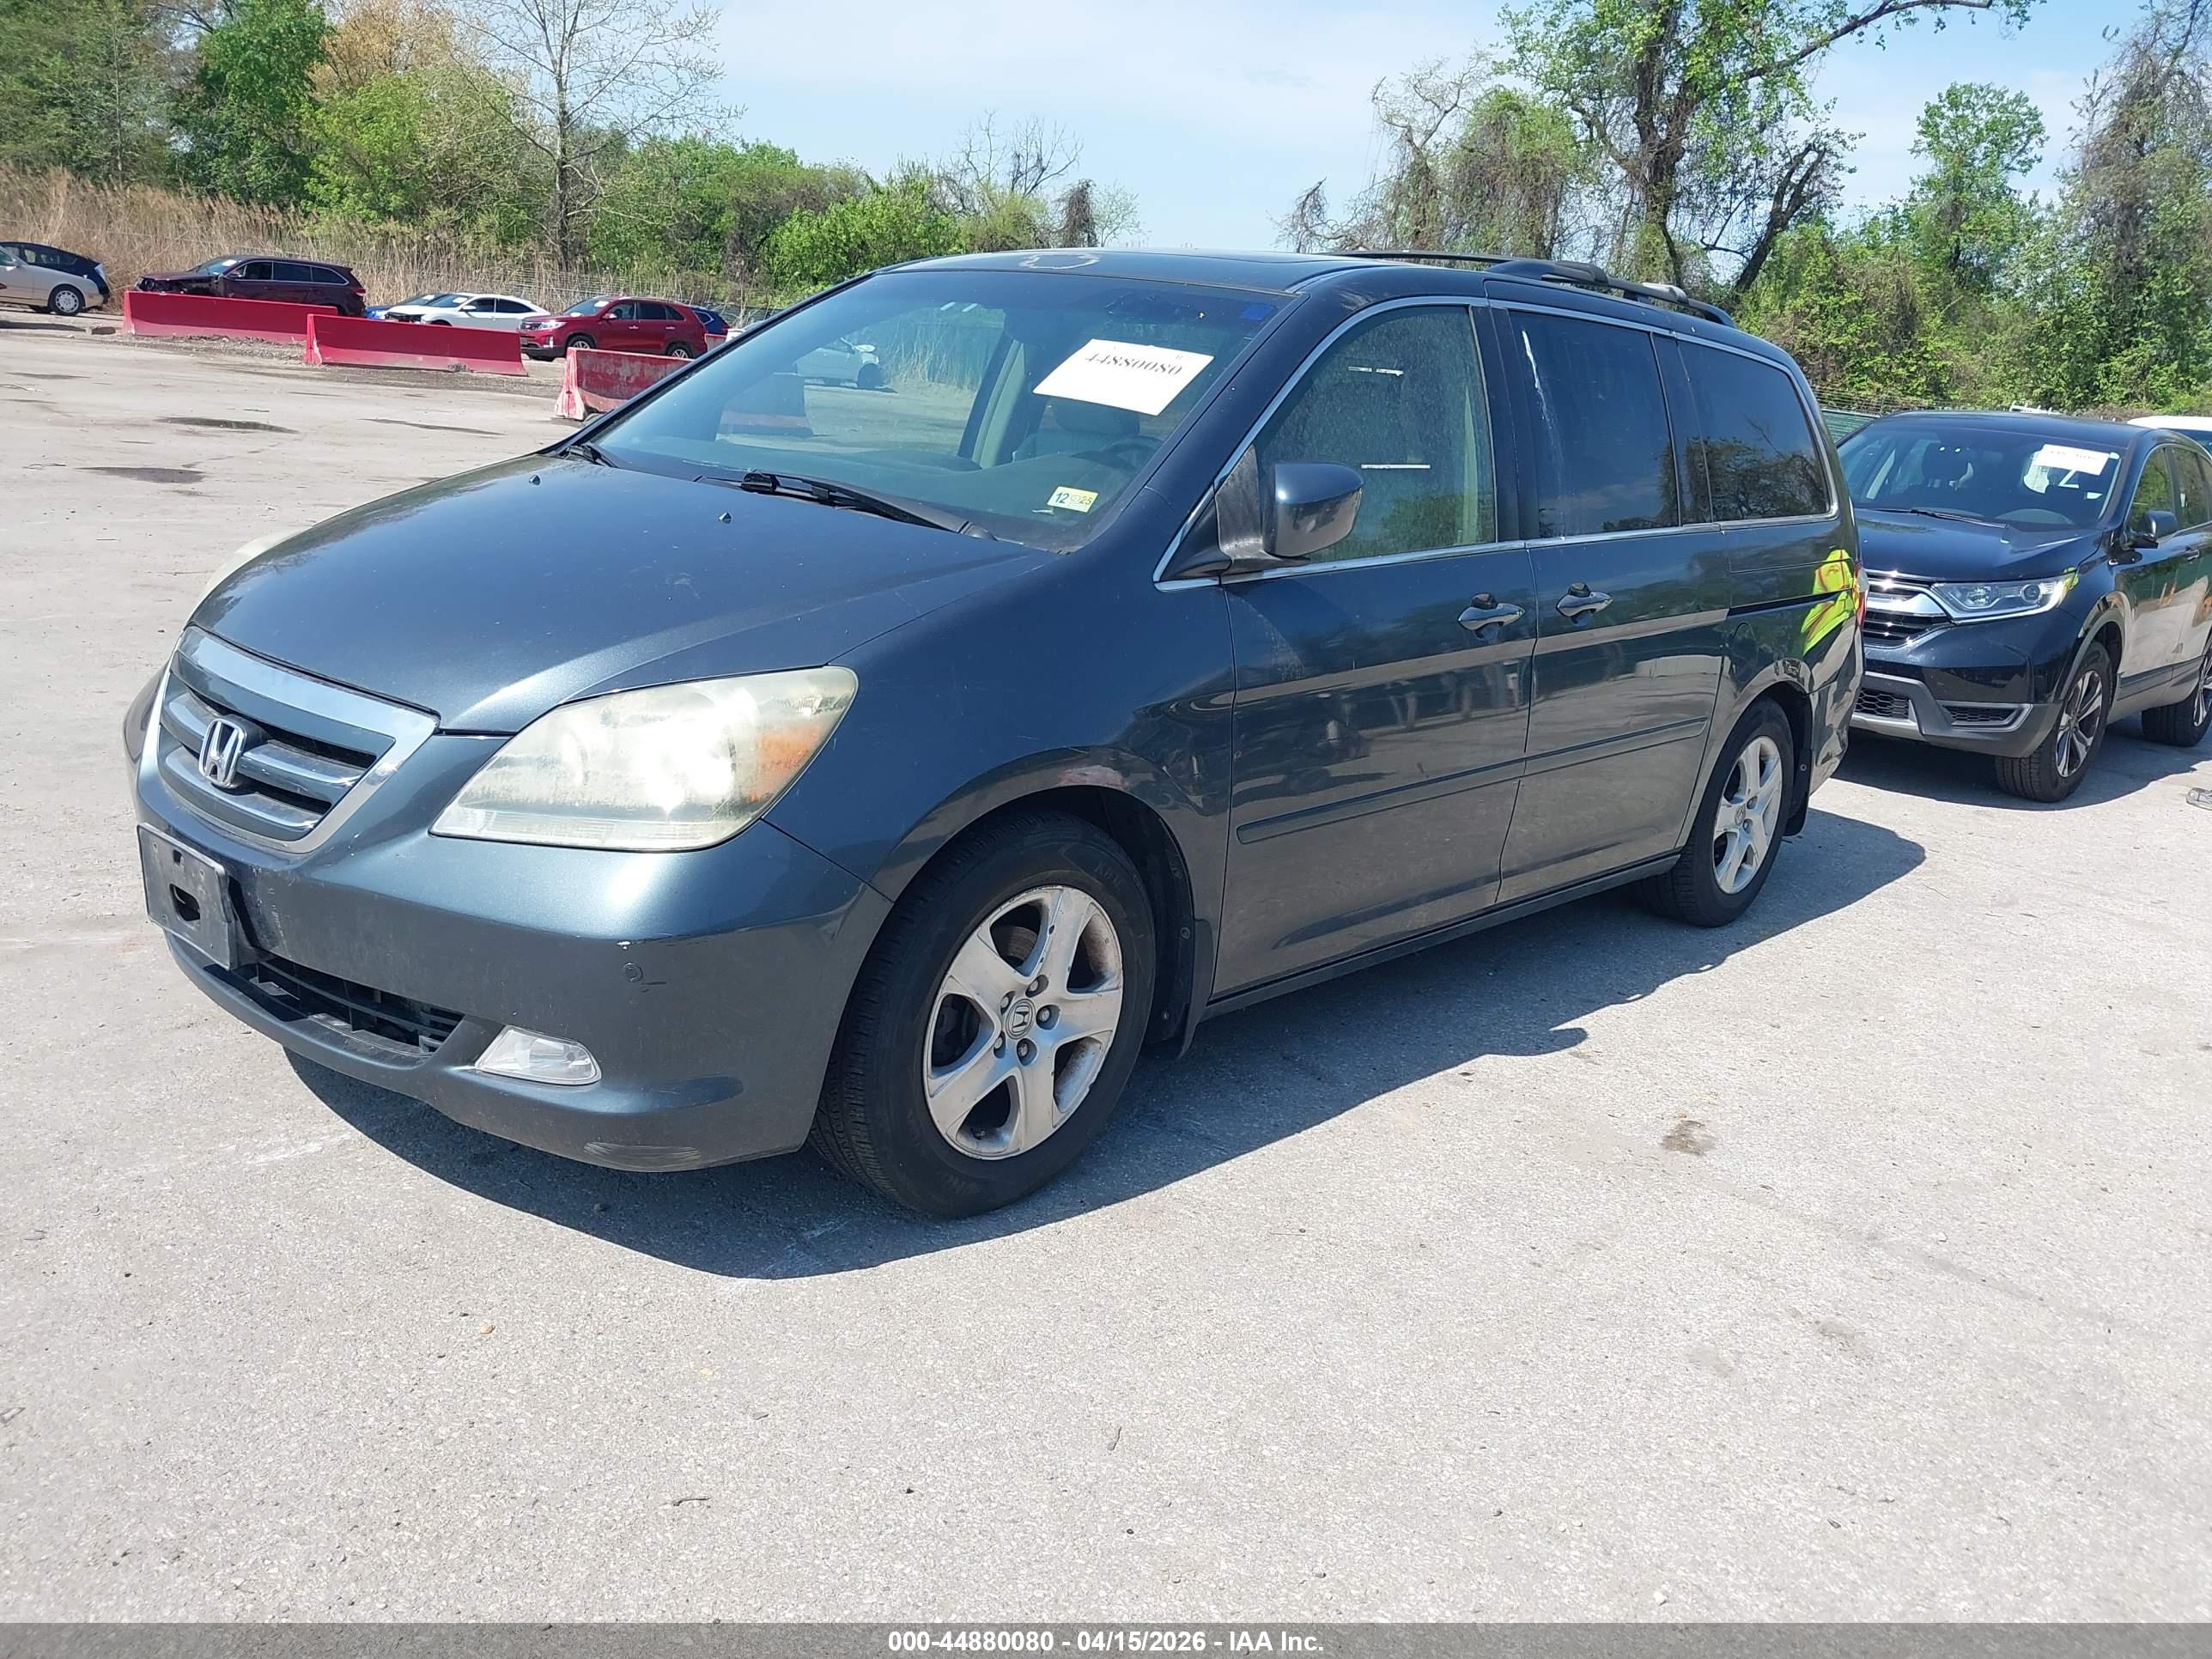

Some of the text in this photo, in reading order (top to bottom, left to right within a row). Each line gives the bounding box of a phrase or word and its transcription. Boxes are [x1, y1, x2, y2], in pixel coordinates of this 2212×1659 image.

[1085, 352, 1182, 375] 44880080
[1055, 492, 1093, 505] 12 25
